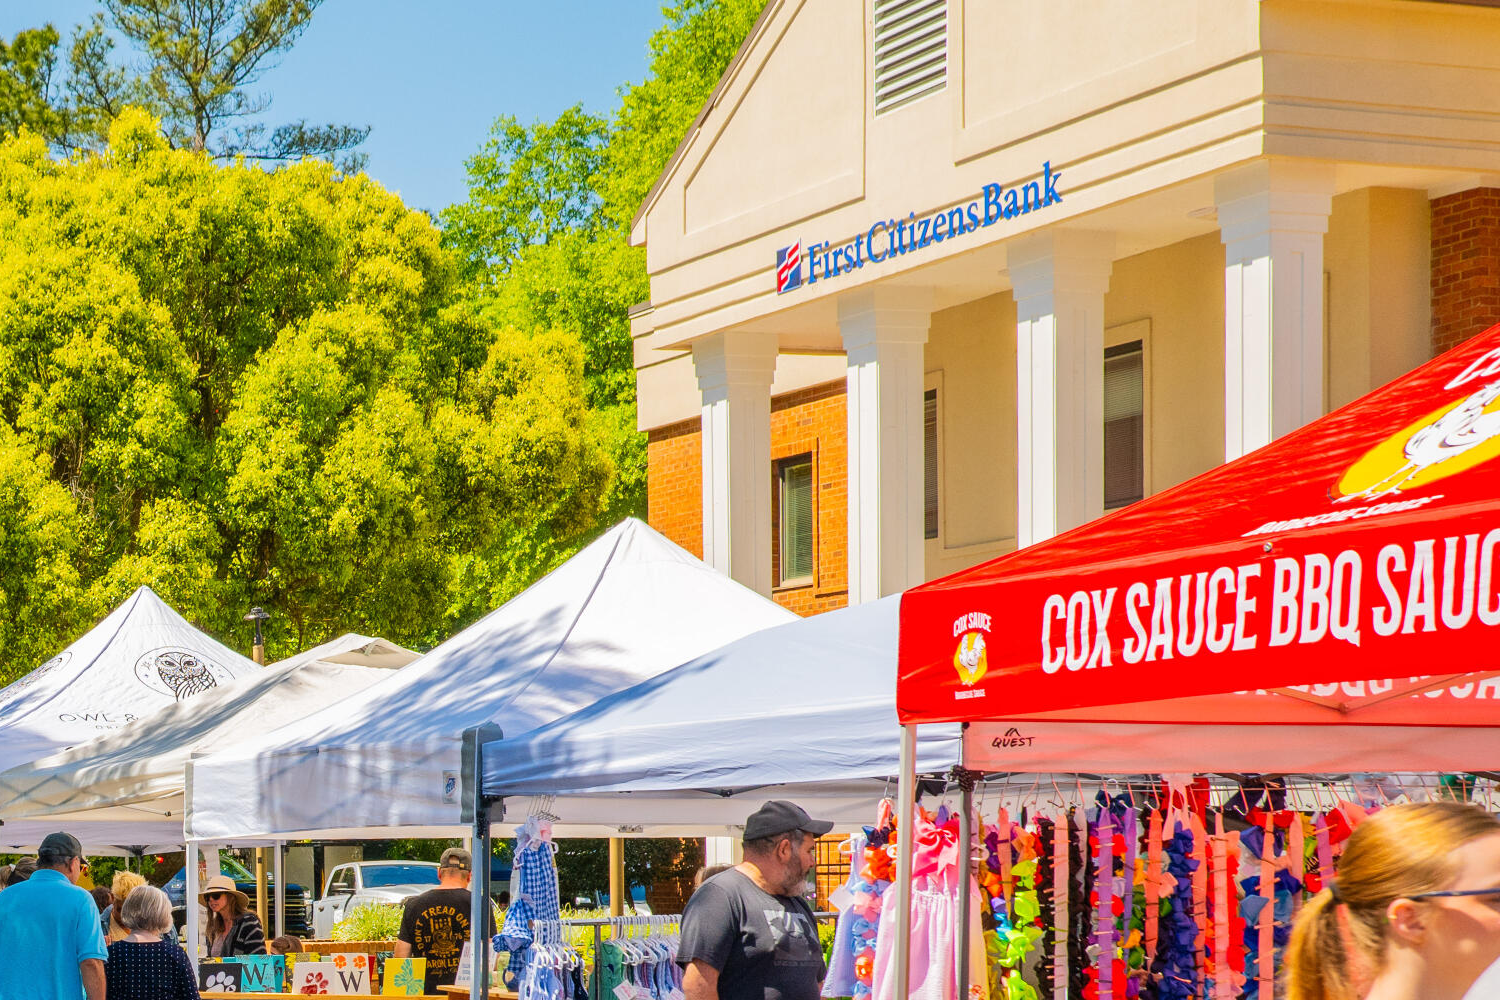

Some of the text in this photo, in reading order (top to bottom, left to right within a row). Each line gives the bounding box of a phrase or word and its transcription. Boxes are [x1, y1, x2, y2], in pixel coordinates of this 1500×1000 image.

[1041, 528, 1500, 674] COX SAUCE BBQ SAUC
[953, 612, 992, 637] COX SAUCE
[59, 713, 116, 723] OWL
[991, 736, 1036, 748] QUEST
[421, 905, 456, 920] TREAD
[455, 913, 469, 929] ON
